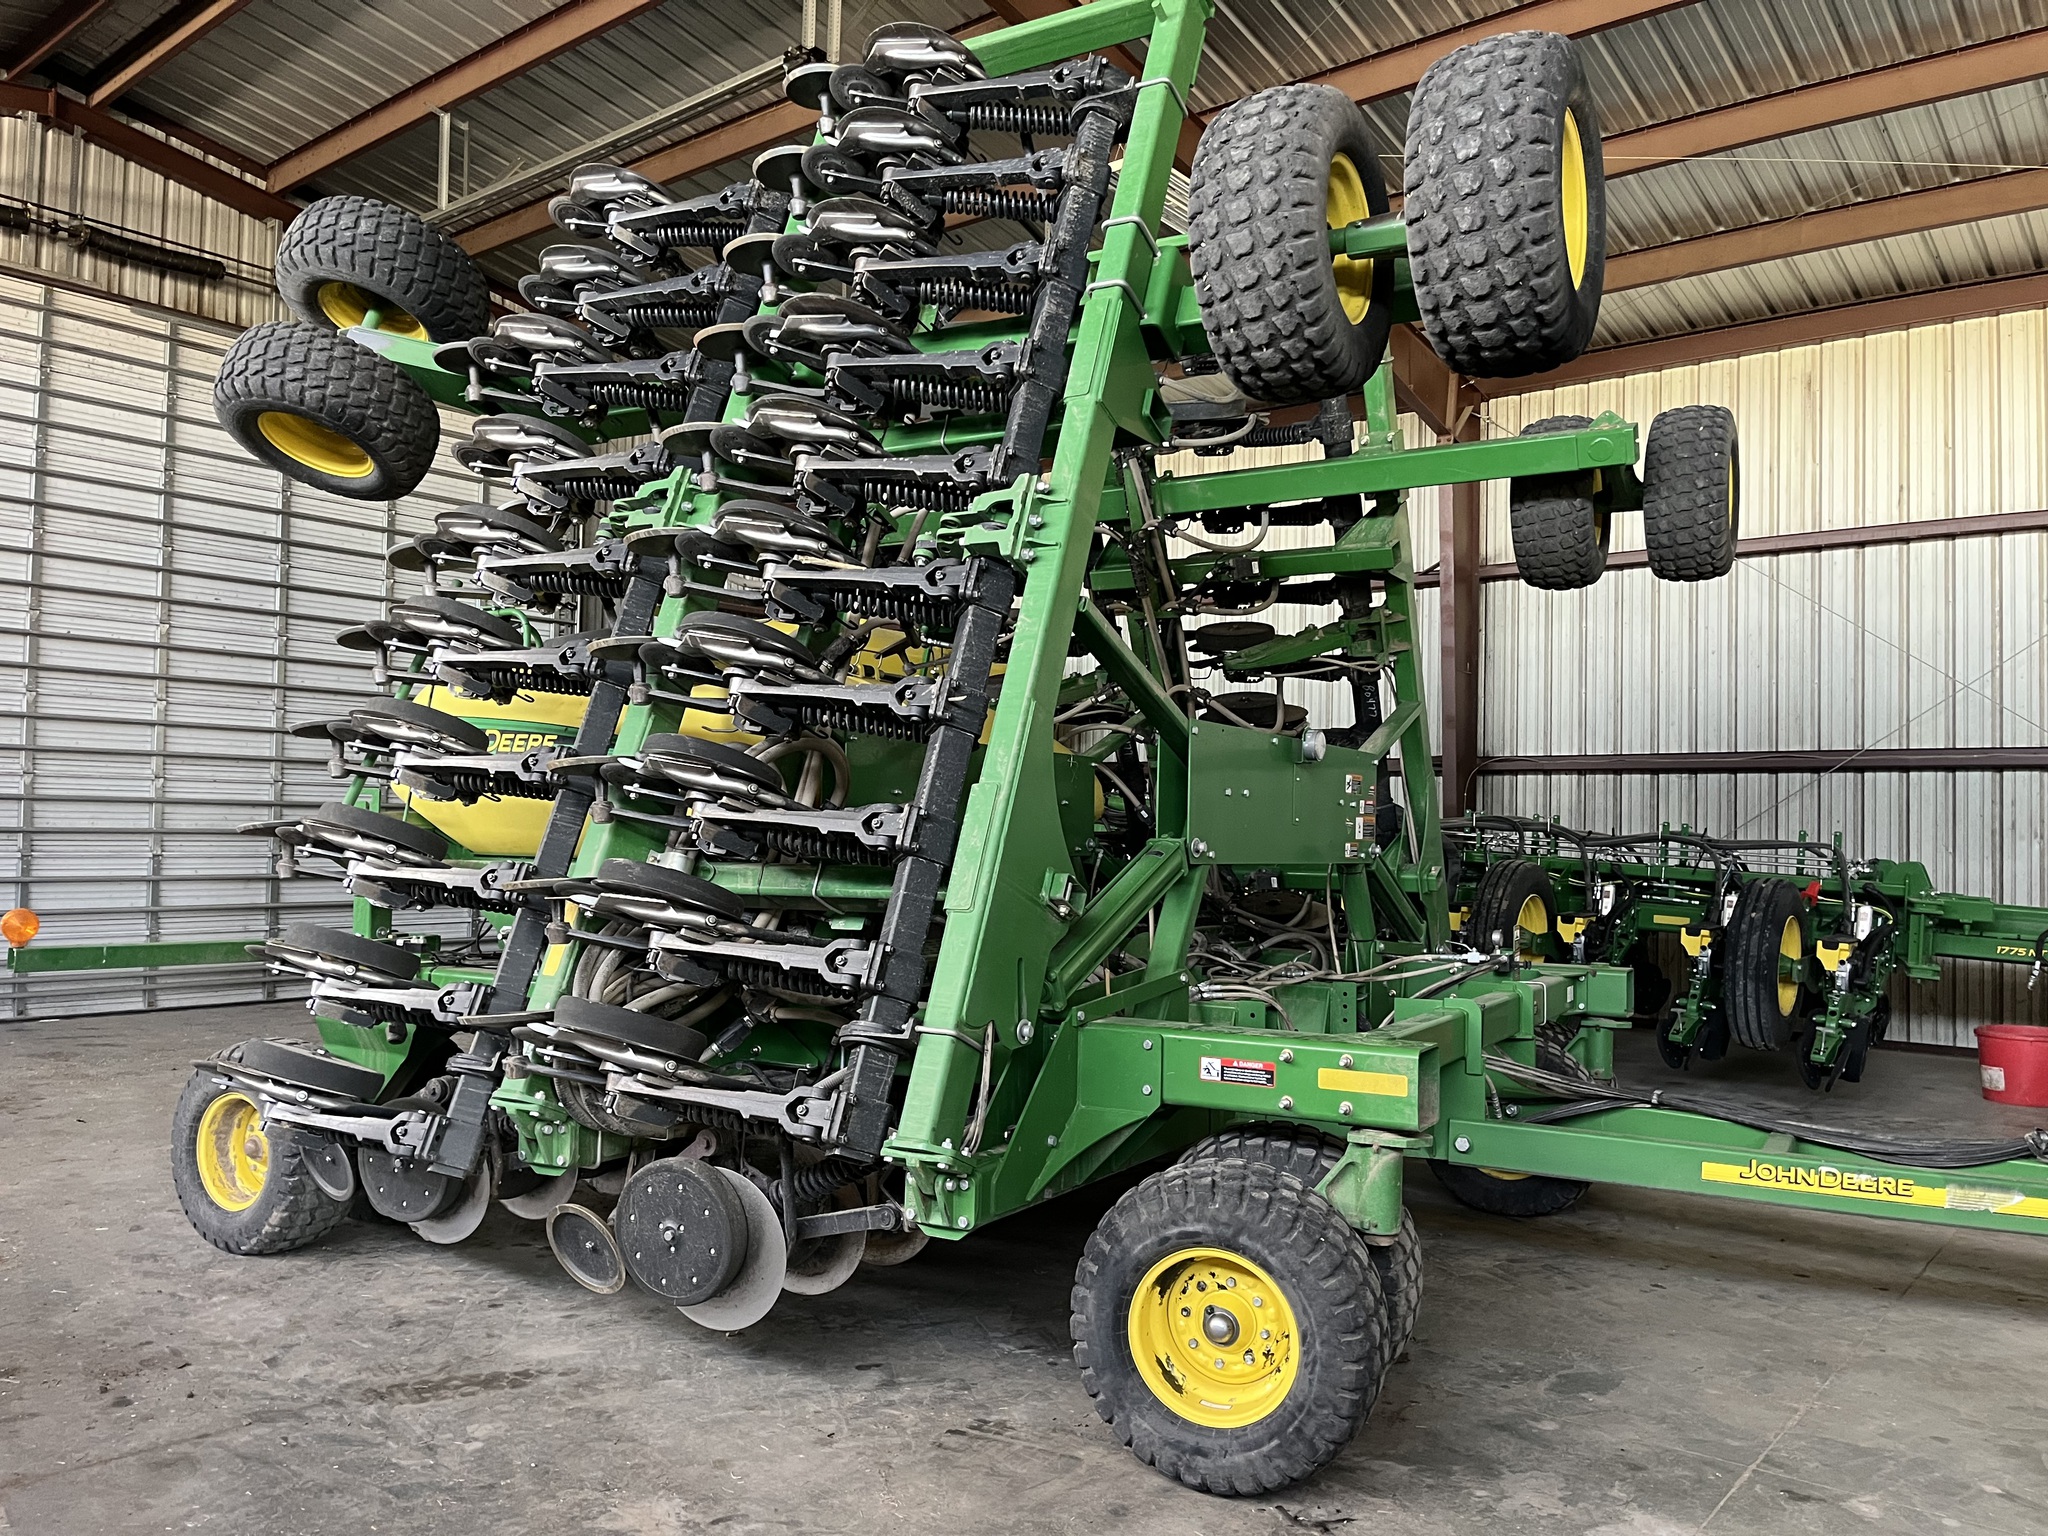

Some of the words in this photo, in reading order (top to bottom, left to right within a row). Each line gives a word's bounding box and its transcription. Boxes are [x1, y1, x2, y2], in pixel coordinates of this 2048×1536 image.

[1996, 945, 2027, 957] 1775
[1238, 1060, 1264, 1069] DANGER
[1740, 1159, 1815, 1187] JOHN
[1817, 1166, 1915, 1198] DEERE
